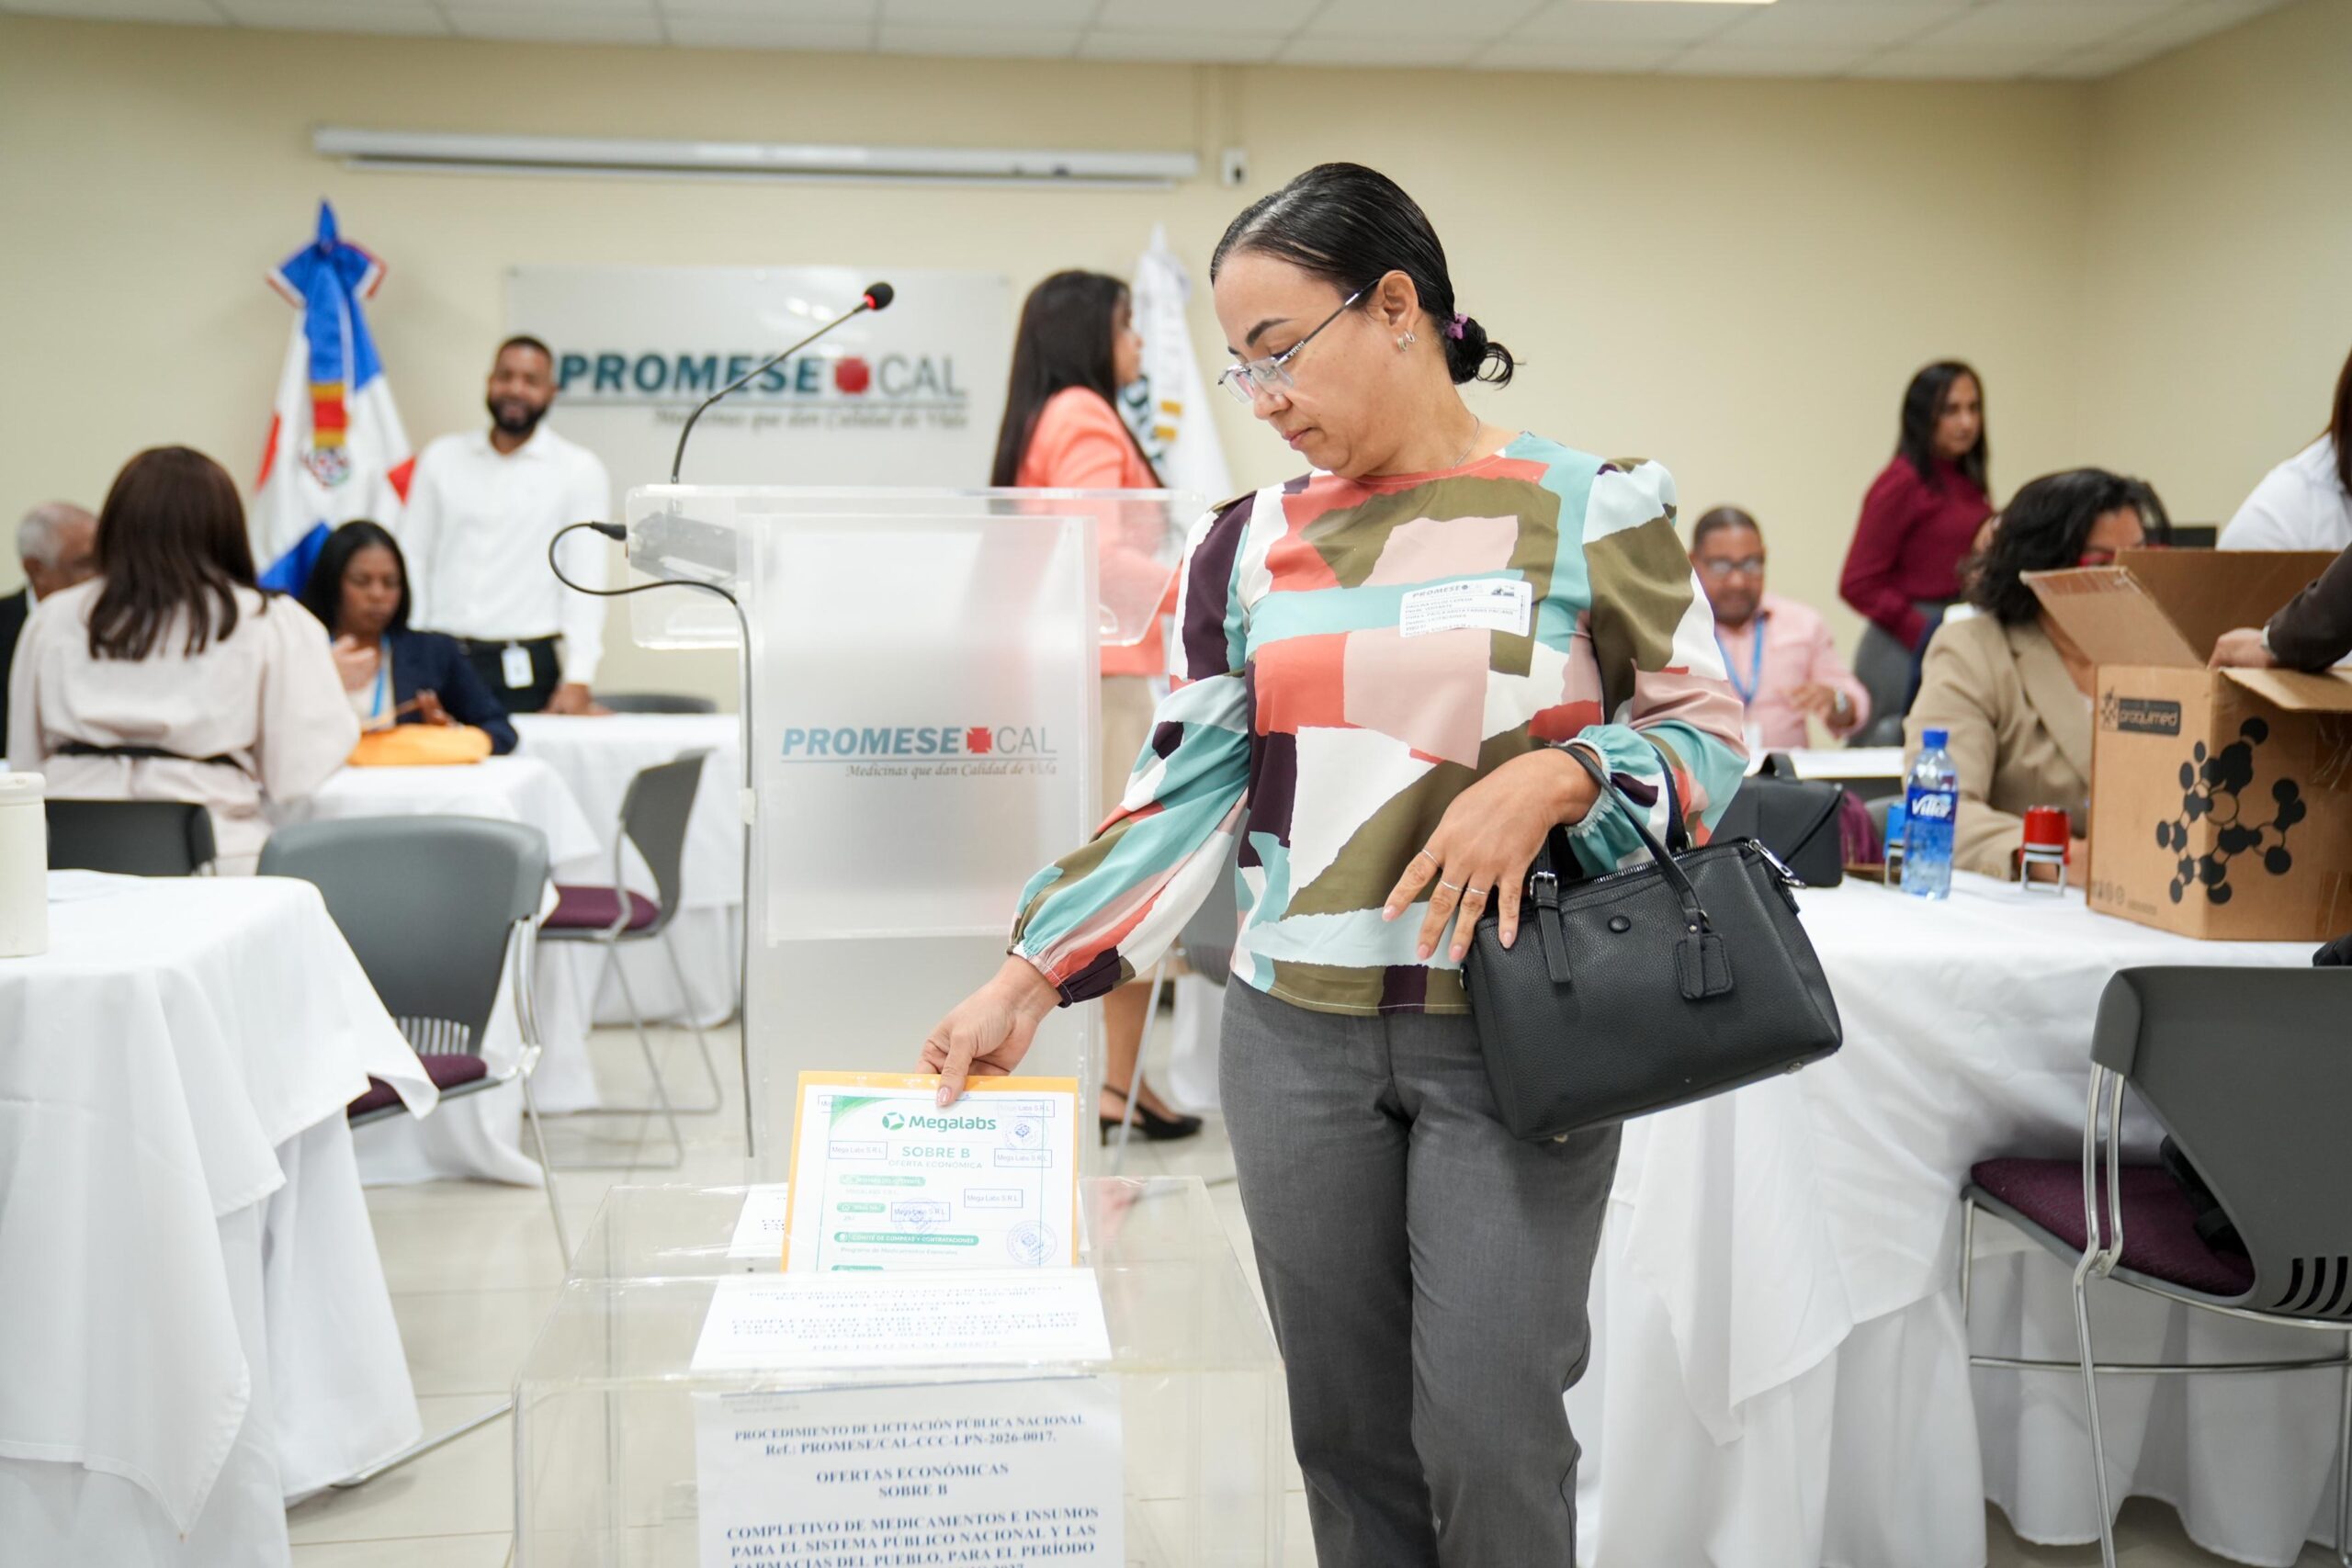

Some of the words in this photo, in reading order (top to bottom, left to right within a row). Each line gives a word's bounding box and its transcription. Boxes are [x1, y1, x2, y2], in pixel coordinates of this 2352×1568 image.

[556, 353, 824, 395] PROMESE
[876, 355, 967, 398] CAL
[782, 727, 962, 756] PROMESE
[995, 726, 1057, 754] CAL
[844, 762, 909, 777] Medicinas
[910, 766, 933, 780] que
[934, 761, 958, 776] dan
[961, 761, 1009, 777] Calidad
[1010, 761, 1024, 776] de
[909, 1115, 997, 1133] Megalabs
[831, 1145, 850, 1155] Mega
[901, 1145, 956, 1158] SOBRE
[960, 1147, 971, 1159] B
[997, 1153, 1014, 1163] Mega
[888, 1159, 923, 1168] OFERTA
[967, 1194, 984, 1203] Mega
[886, 1235, 915, 1243] COMPRAS
[735, 1426, 848, 1441] PROCEDIMIENTO
[852, 1424, 868, 1435] DE
[873, 1417, 953, 1434] LICITACIÓN
[956, 1415, 1012, 1429] PÚBLICA
[1016, 1414, 1084, 1427] NACIONAL
[816, 1467, 893, 1483] OFERTAS
[897, 1461, 1010, 1480] ECONÓMICAS
[878, 1483, 933, 1498] SOBRE
[937, 1483, 949, 1496] B
[727, 1521, 840, 1540] COMPLETIVO
[843, 1518, 866, 1532] DE
[870, 1512, 1006, 1531] MEDICAMENTOS
[1010, 1511, 1020, 1523] E
[1024, 1506, 1100, 1522] INSUMOS
[730, 1542, 776, 1558] PARA
[780, 1540, 802, 1554] EL
[805, 1536, 879, 1552] SISTEMA
[882, 1530, 956, 1549] PÚBLICO
[959, 1526, 1046, 1544] NACIONAL
[1050, 1525, 1061, 1538] Y
[1065, 1523, 1097, 1537] LAS
[836, 1555, 870, 1568] DEL
[874, 1550, 944, 1567] PUEBLO,
[947, 1547, 991, 1562] PARA
[995, 1546, 1017, 1559] EL
[1021, 1540, 1096, 1558] PERÍODO
